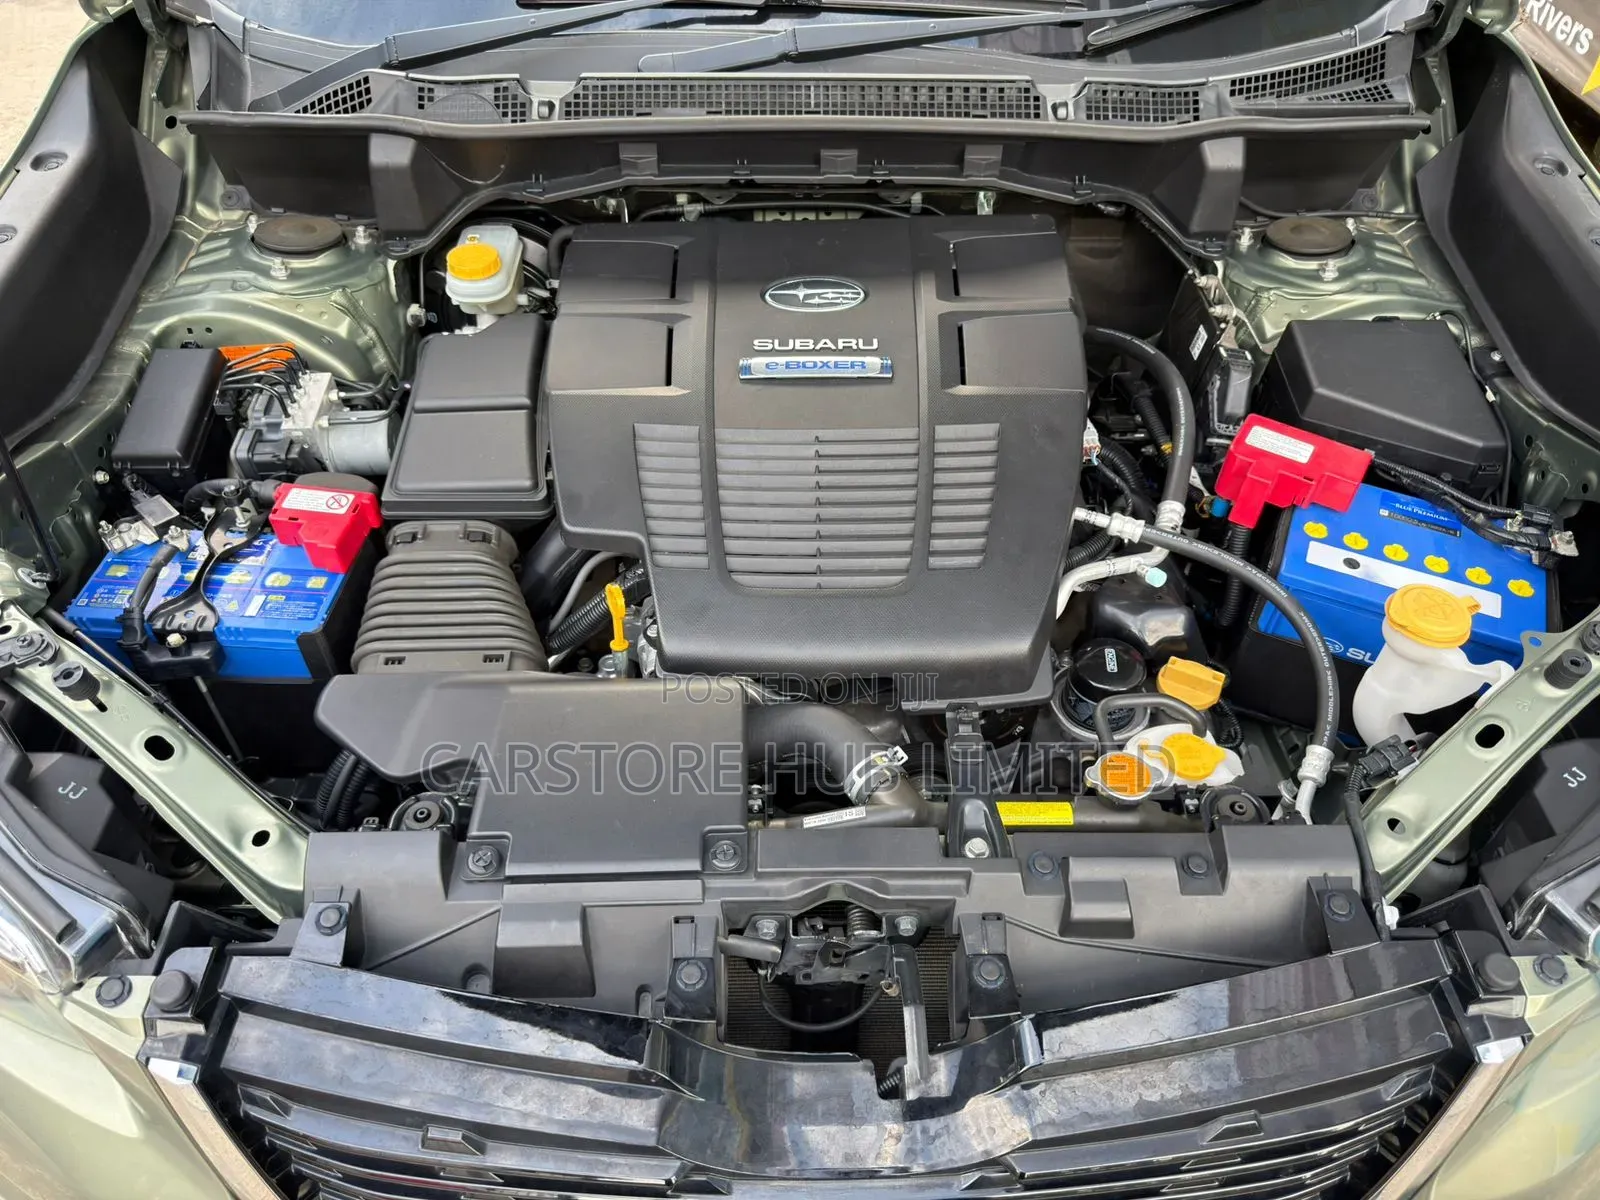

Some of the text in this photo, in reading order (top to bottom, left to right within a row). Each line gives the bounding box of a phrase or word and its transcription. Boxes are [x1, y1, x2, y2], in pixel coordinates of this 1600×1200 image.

[1526, 0, 1594, 55] Rivers
[752, 338, 879, 351] SUBARU
[765, 360, 867, 371] e-BOXER
[1563, 766, 1587, 788] JJ
[57, 781, 88, 799] JJ
